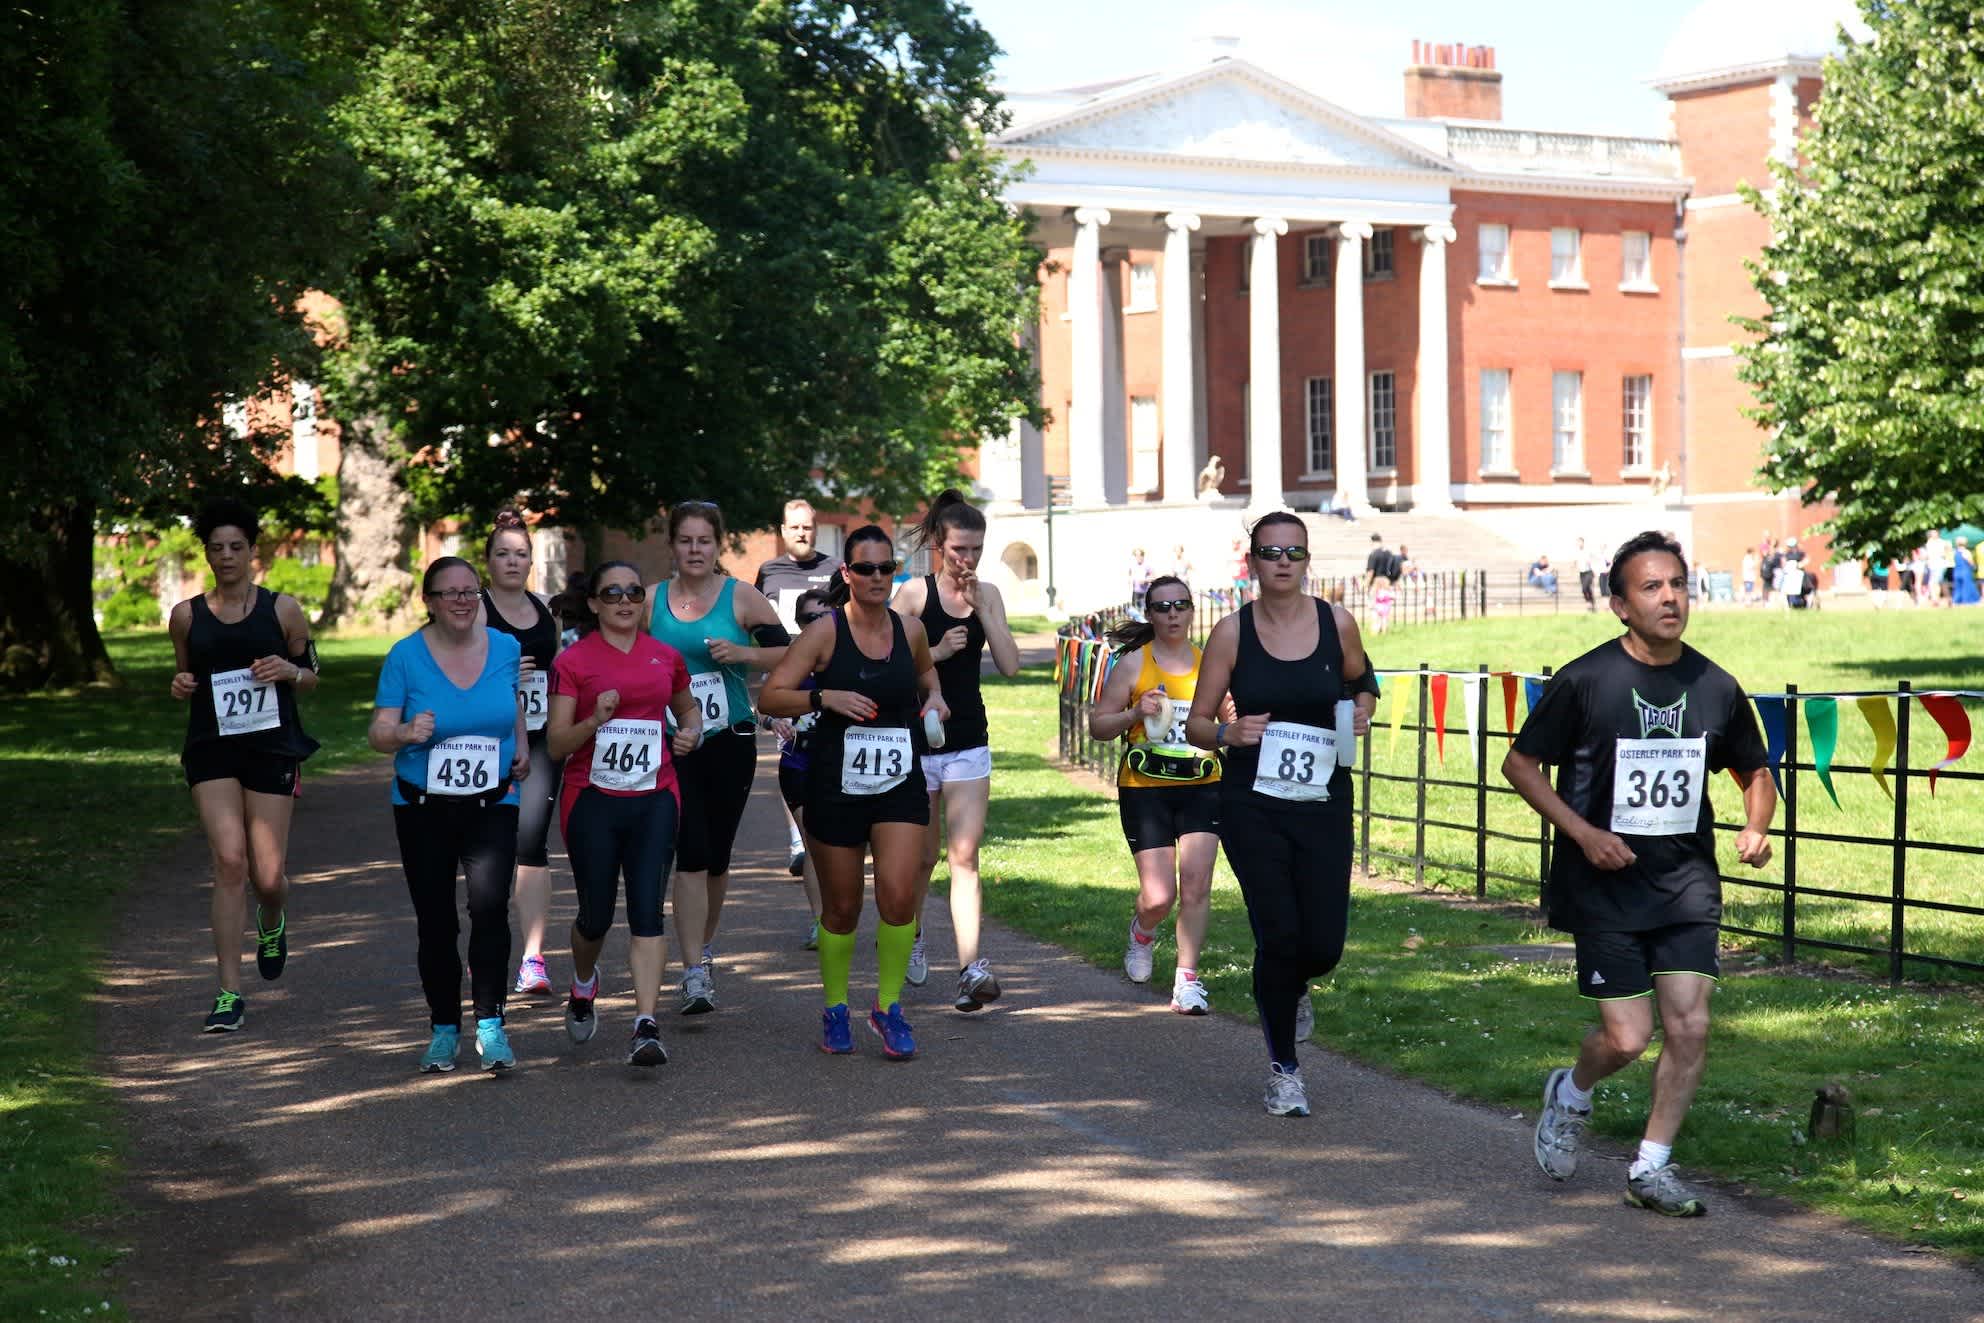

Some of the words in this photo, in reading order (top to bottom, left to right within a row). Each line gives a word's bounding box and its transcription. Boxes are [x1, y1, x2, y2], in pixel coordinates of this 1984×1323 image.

[223, 686, 267, 717] 297
[518, 690, 541, 715] 05
[1637, 699, 1684, 734] TAPOUT
[629, 728, 646, 736] PARK
[846, 732, 875, 742] OSTERLEY
[877, 735, 894, 743] PARK
[1265, 728, 1300, 740] OSTERLEY
[1302, 733, 1320, 744] PARK
[1322, 737, 1336, 746] 10K
[464, 743, 482, 751] PARK
[484, 744, 497, 752] 10K
[602, 742, 650, 773] 464
[852, 747, 902, 777] 413
[1620, 750, 1659, 759] OSTERLEY
[1661, 750, 1684, 759] PARK
[1686, 749, 1702, 758] 10K
[437, 758, 488, 788] 436
[1278, 748, 1315, 784] 83
[1627, 769, 1691, 808] 363
